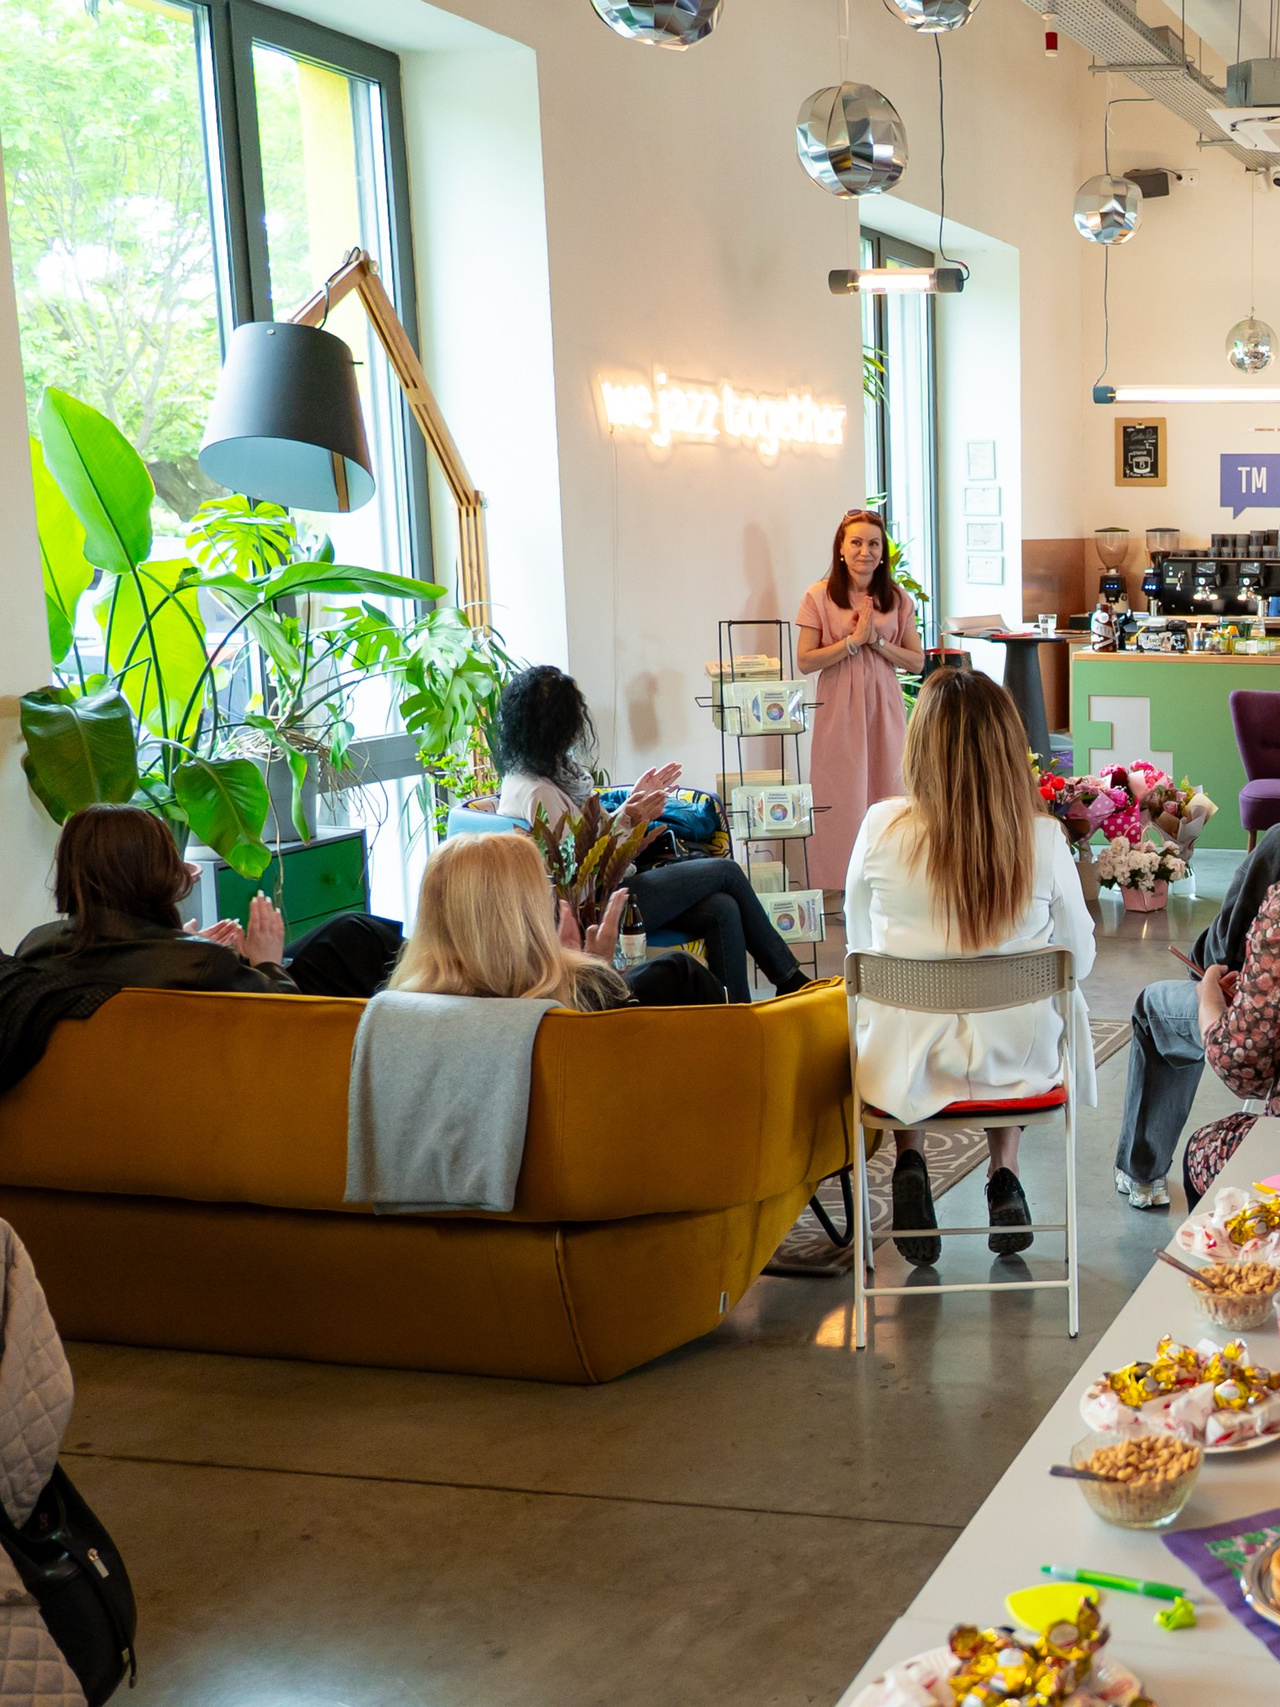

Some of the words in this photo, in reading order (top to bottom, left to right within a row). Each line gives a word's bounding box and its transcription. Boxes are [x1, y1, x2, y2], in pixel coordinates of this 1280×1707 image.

[602, 382, 652, 429] we
[650, 372, 721, 448] jazz
[721, 382, 847, 456] together
[1237, 466, 1267, 494] TM
